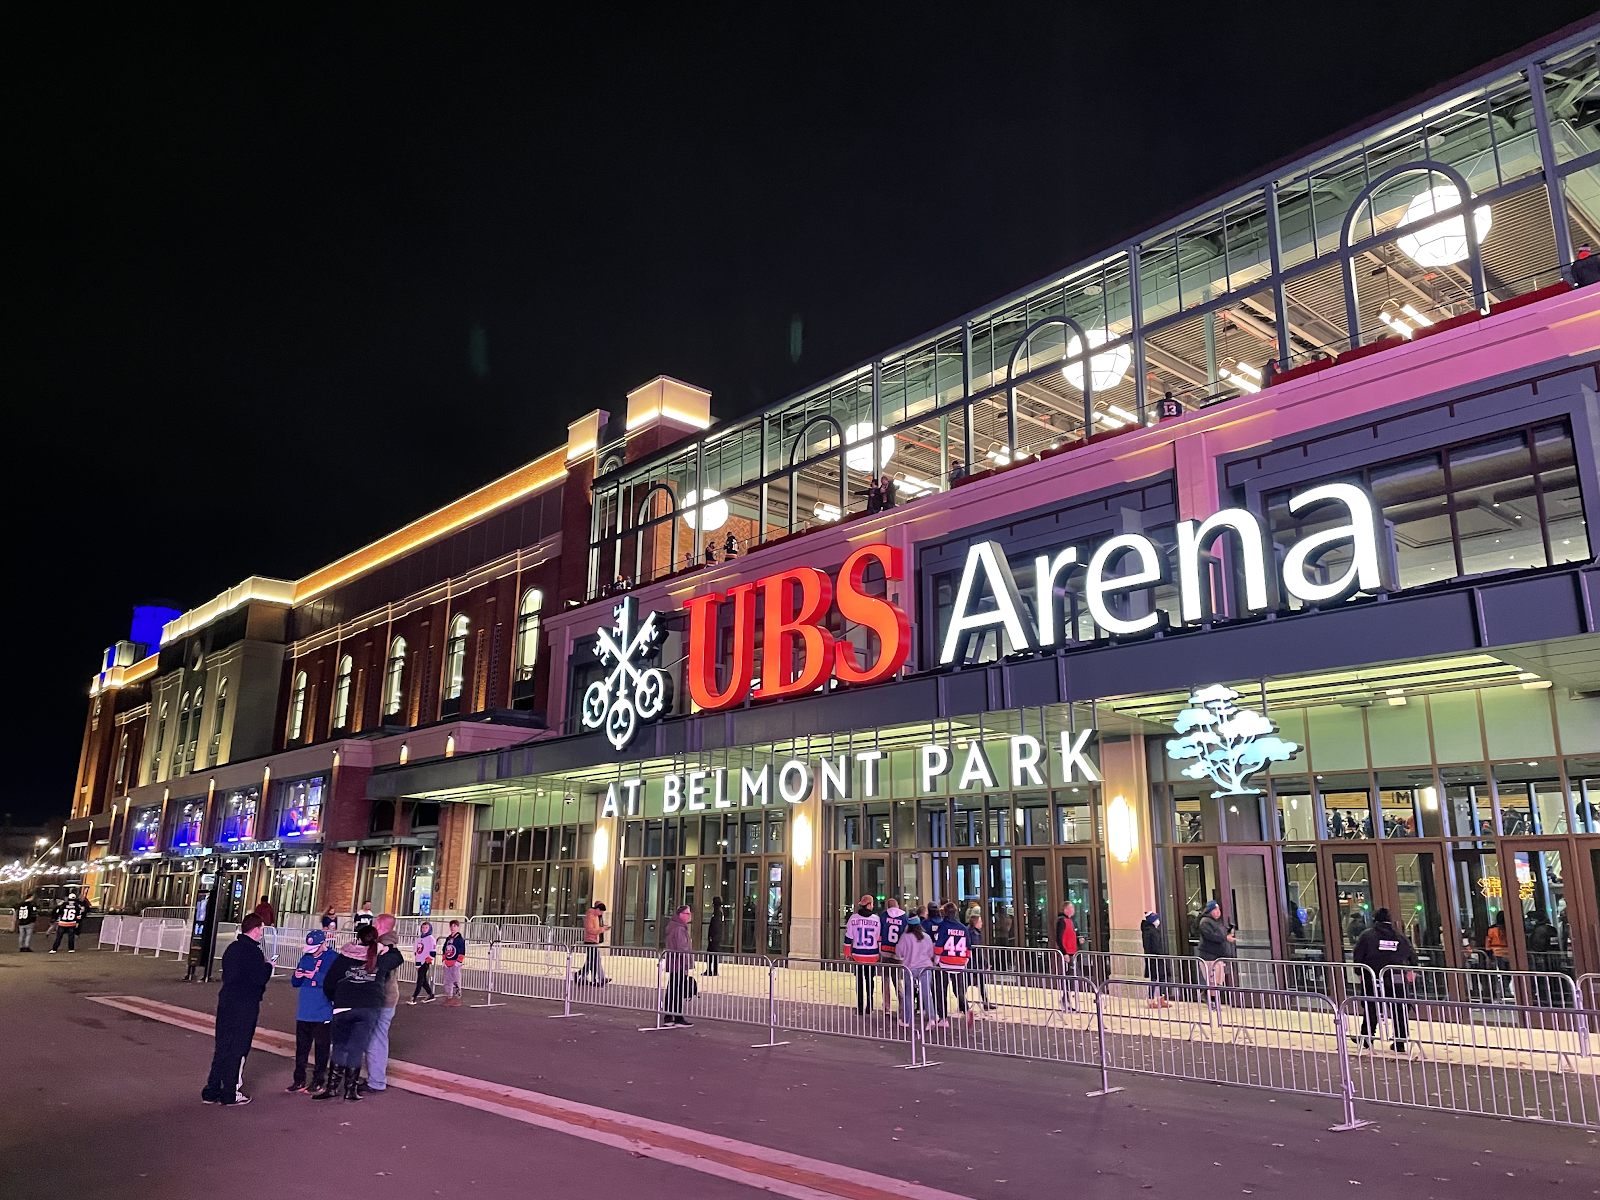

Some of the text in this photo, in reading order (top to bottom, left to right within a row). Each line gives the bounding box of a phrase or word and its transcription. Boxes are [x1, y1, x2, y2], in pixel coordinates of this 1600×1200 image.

[1163, 405, 1177, 416] 13
[684, 483, 1384, 711] UBS Arena
[601, 729, 1103, 818] AT BELMONT PARK
[61, 908, 76, 920] 16
[851, 918, 879, 927] CLUTTERBUCK
[856, 927, 875, 946] 15
[887, 924, 900, 943] 6
[943, 936, 967, 957] 44
